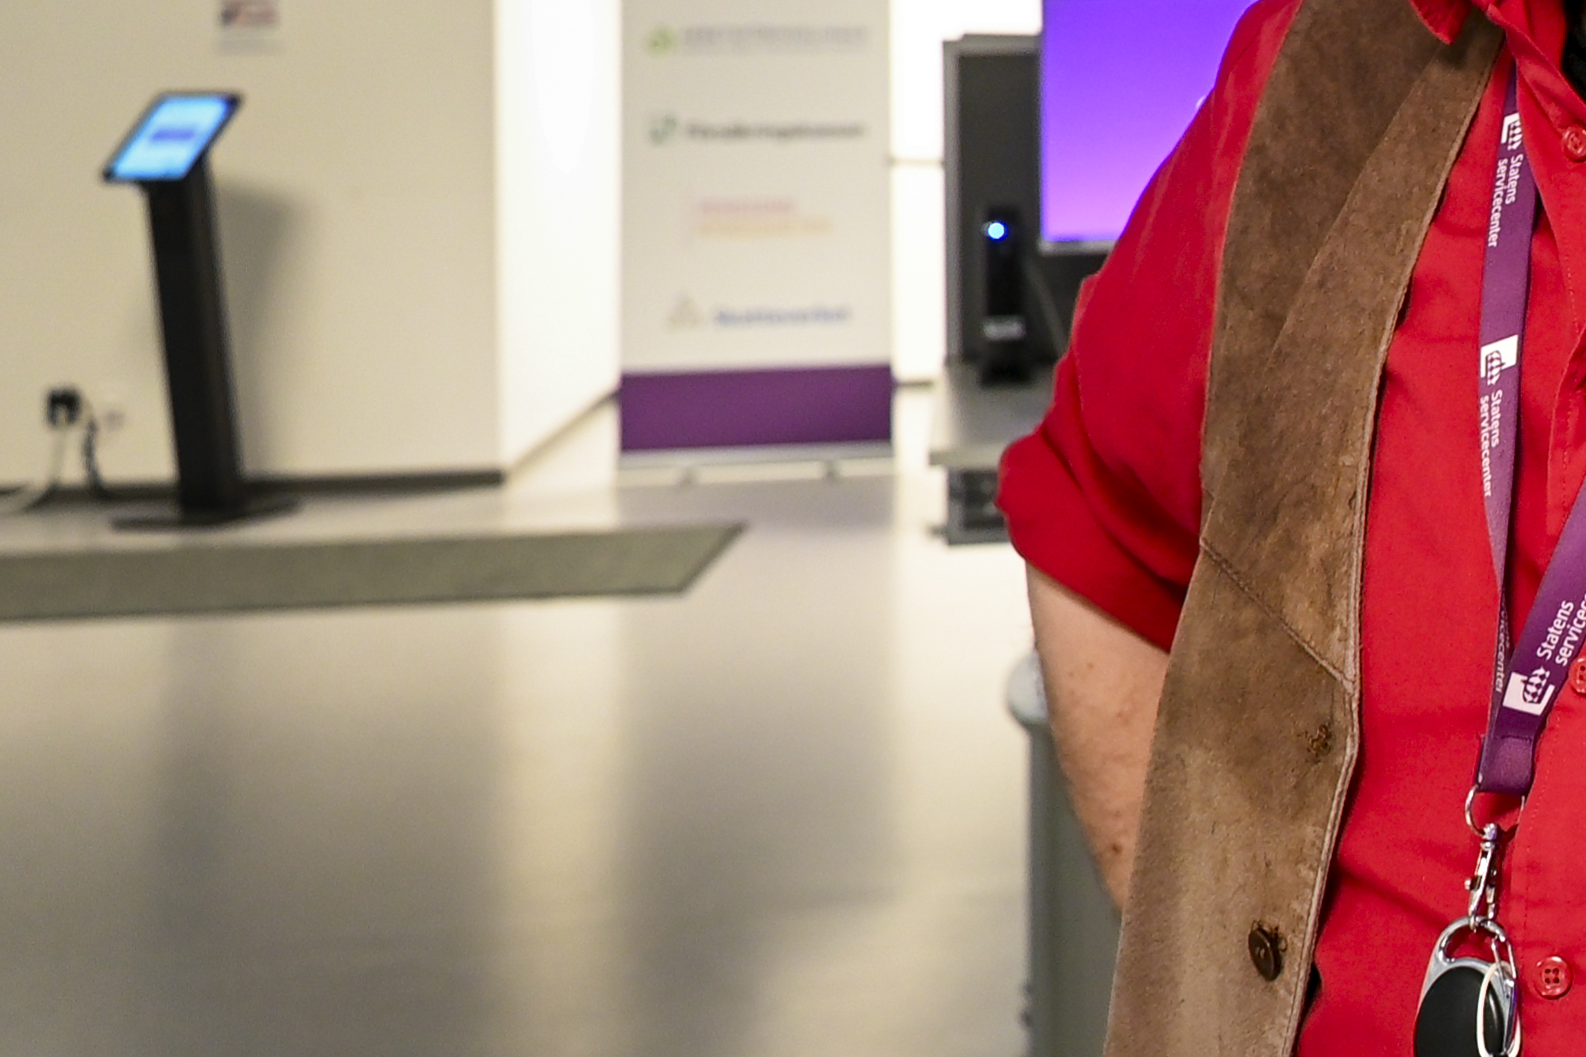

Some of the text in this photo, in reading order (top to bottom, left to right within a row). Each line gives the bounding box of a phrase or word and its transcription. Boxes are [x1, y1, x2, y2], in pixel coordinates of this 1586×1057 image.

[1488, 158, 1509, 248] servicecenter
[1505, 153, 1524, 205] Statens
[1479, 395, 1492, 497] servicecenter
[1491, 389, 1503, 448] Statens
[1536, 600, 1575, 661] Statens
